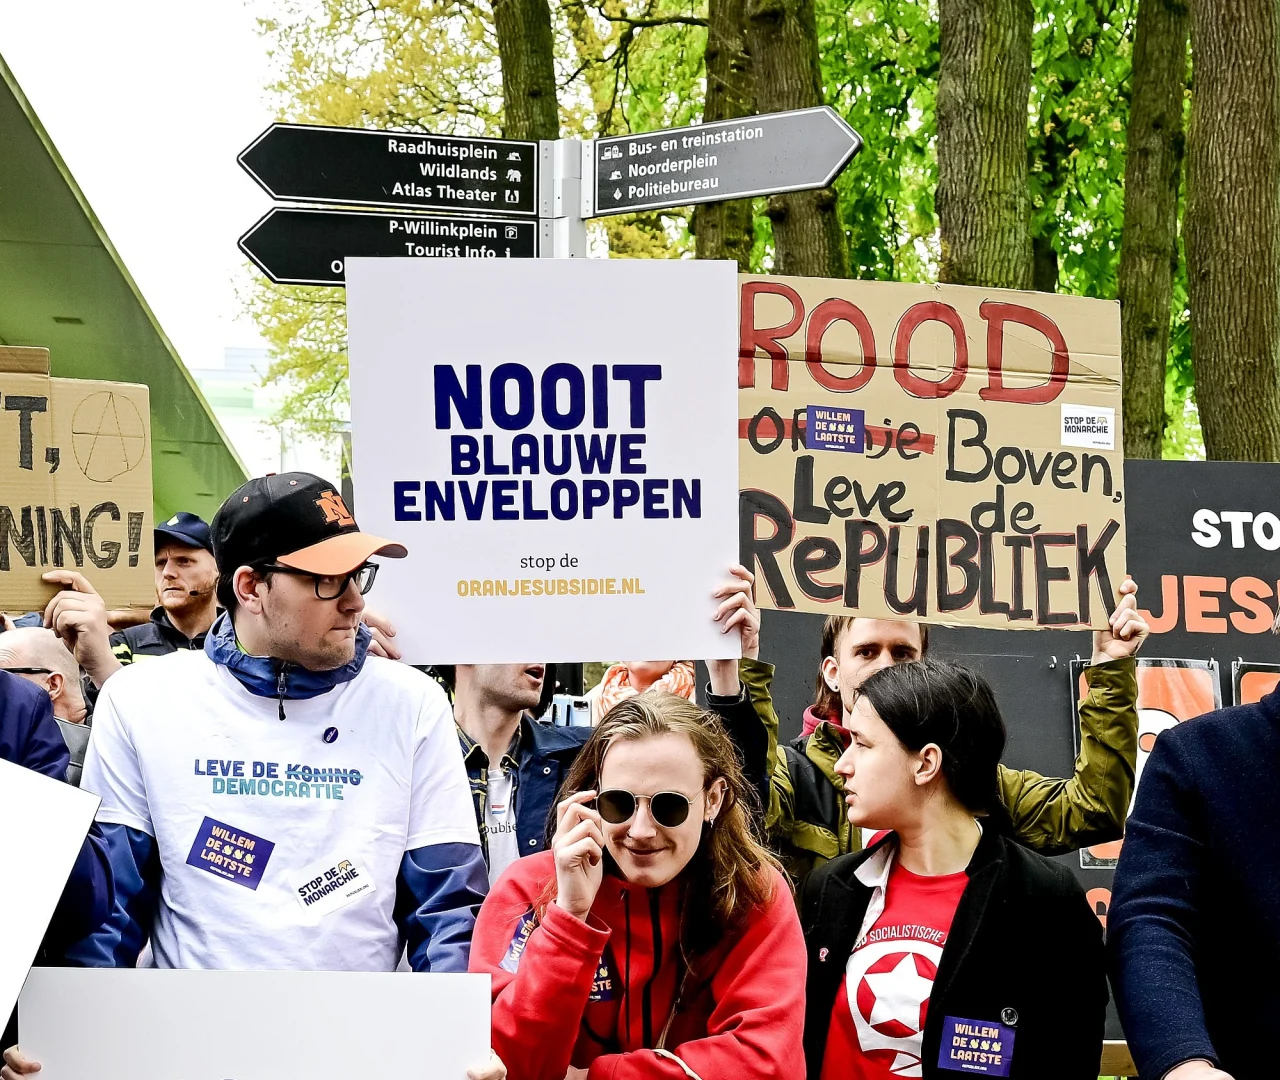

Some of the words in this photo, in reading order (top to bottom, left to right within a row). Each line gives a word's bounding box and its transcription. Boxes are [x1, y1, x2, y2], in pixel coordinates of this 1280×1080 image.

[387, 139, 498, 160] Raadhuisplein
[628, 142, 658, 157] Bus-
[661, 139, 678, 152] en
[681, 126, 764, 149] treinstation
[419, 162, 498, 181] Wildlands
[628, 154, 718, 178] Noorderplein
[391, 182, 432, 198] Atlas
[436, 184, 498, 202] Theater
[628, 177, 719, 199] Politiebureau
[389, 220, 498, 240] P-Willinkplein
[404, 242, 461, 258] Tourist
[465, 245, 497, 258] Info
[738, 281, 1069, 404] ROOD
[432, 362, 662, 431] NOOIT
[815, 410, 851, 422] WILLEM
[815, 421, 828, 431] DE
[1064, 416, 1084, 425] STOP
[1086, 416, 1097, 425] DE
[815, 431, 856, 444] LAATSTE
[1064, 425, 1109, 434] MONARCHIE
[450, 433, 648, 476] BLAUWE
[946, 408, 1123, 503] Boven,
[393, 477, 702, 522] ENVELOPPEN
[792, 455, 915, 525] Leve
[970, 483, 1042, 535] de
[519, 552, 551, 573] stop
[555, 551, 579, 568] de
[456, 576, 646, 598] ORANJESUBSIDIE.NL
[194, 759, 245, 778] LEVE
[252, 761, 280, 779] DE
[212, 777, 345, 801] DEMOCRATIE
[205, 837, 223, 852] DE
[211, 825, 256, 851] WILLEM
[200, 849, 253, 878] LAATSTE
[298, 876, 324, 897] STOP
[324, 866, 340, 881] DE
[303, 867, 360, 906] MONARCHIE
[509, 919, 536, 962] WILLEM
[869, 924, 946, 943] SOCIALISTISCHE
[952, 1035, 968, 1048] DE
[954, 1022, 999, 1039] WILLEM
[950, 1048, 1003, 1065] LAATSTE
